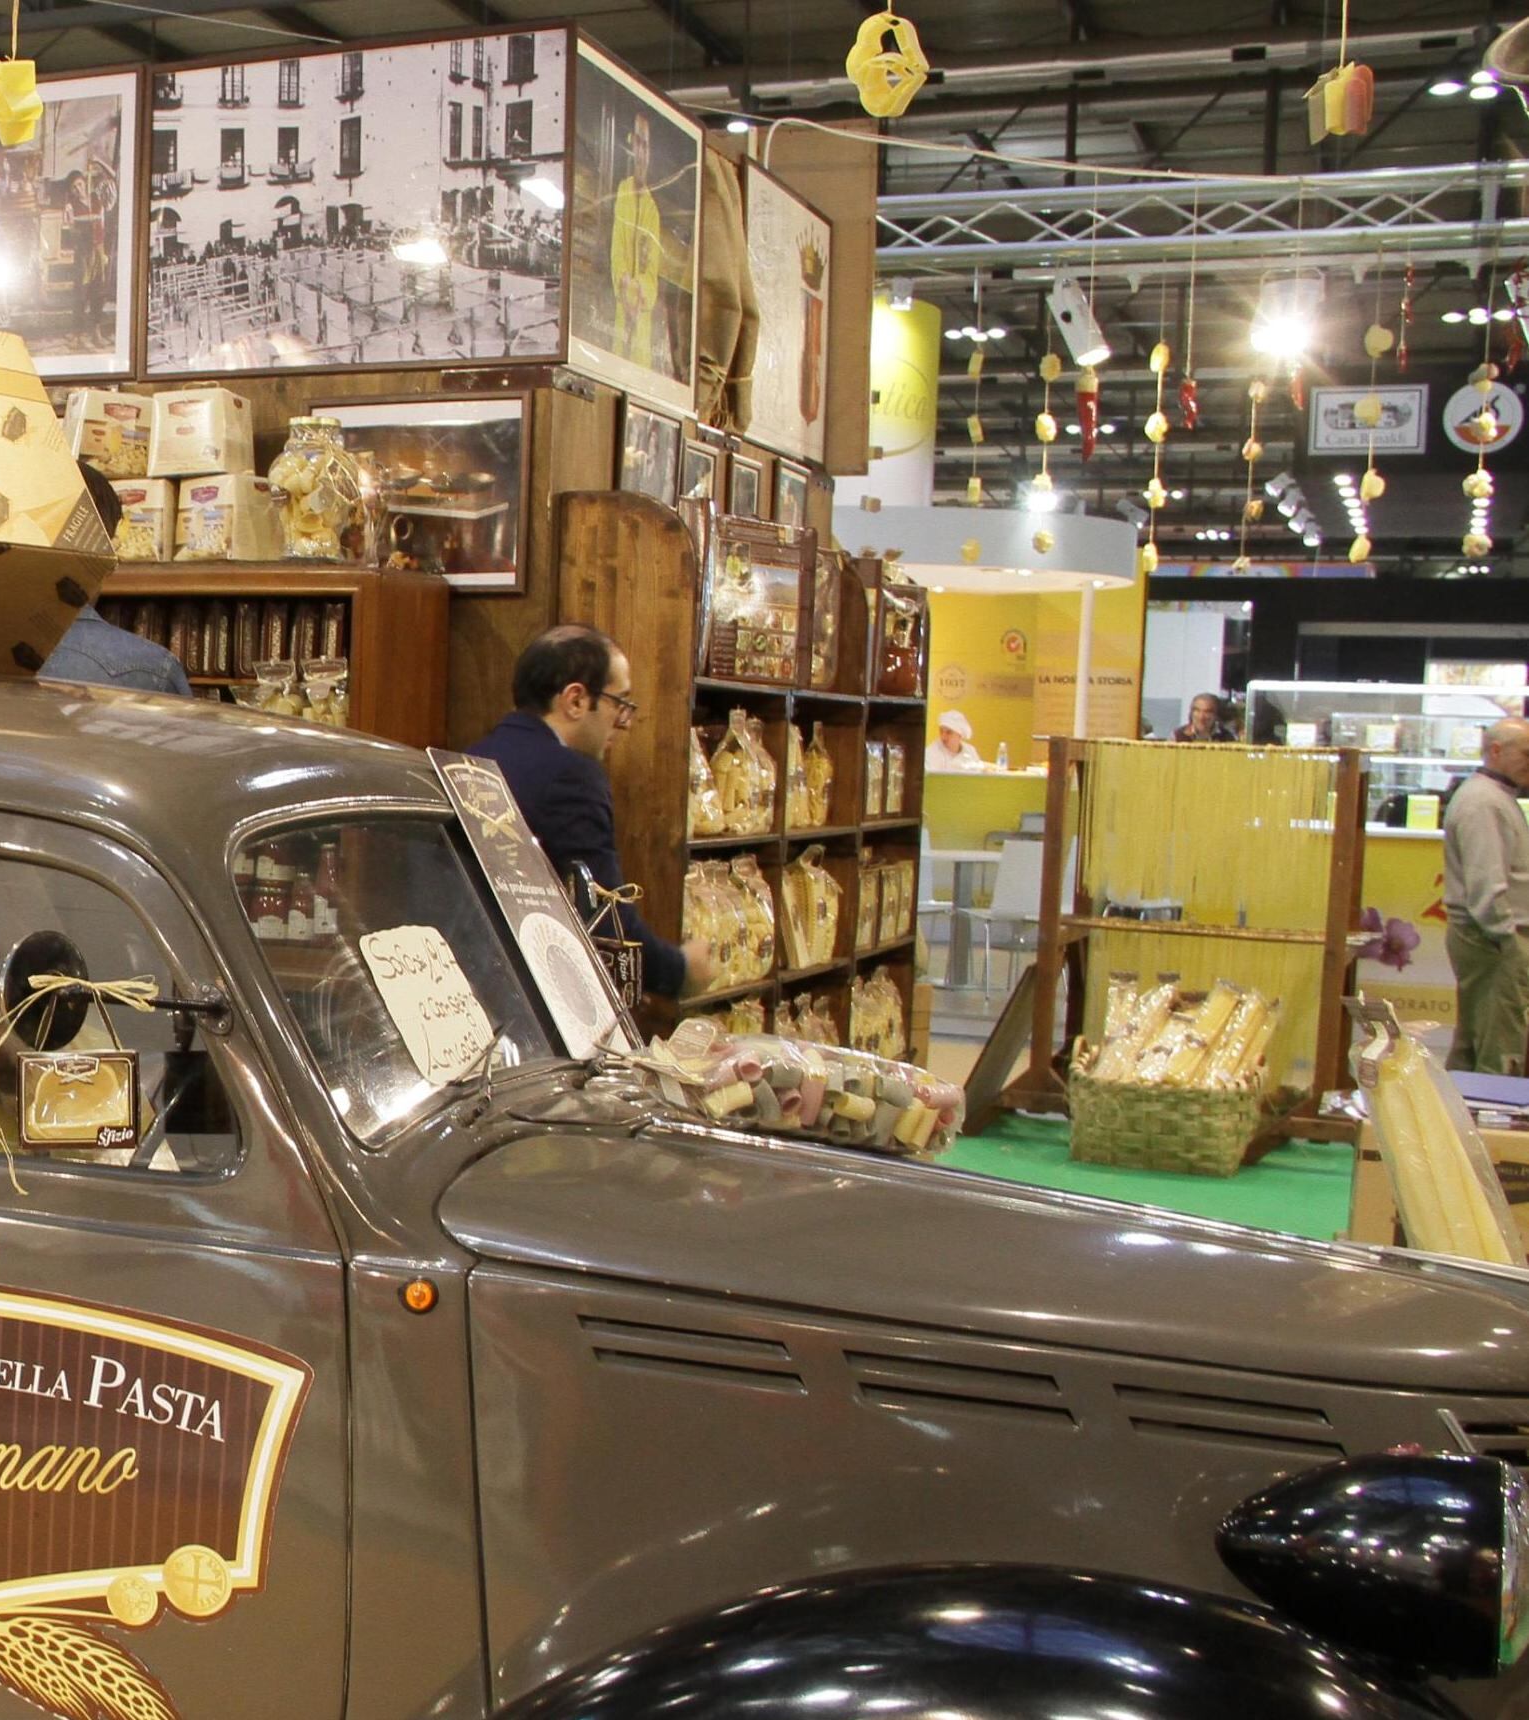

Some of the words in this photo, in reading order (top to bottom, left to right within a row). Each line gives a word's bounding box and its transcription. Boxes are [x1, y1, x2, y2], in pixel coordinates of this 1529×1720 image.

[1360, 431, 1409, 444] Rnaldi
[63, 505, 90, 542] FRAGILE
[1039, 676, 1051, 685] LA
[1054, 676, 1094, 685] NOSA
[1098, 676, 1133, 686] STORIA
[98, 1127, 134, 1147] Sfizio
[83, 1354, 226, 1443] PASTA
